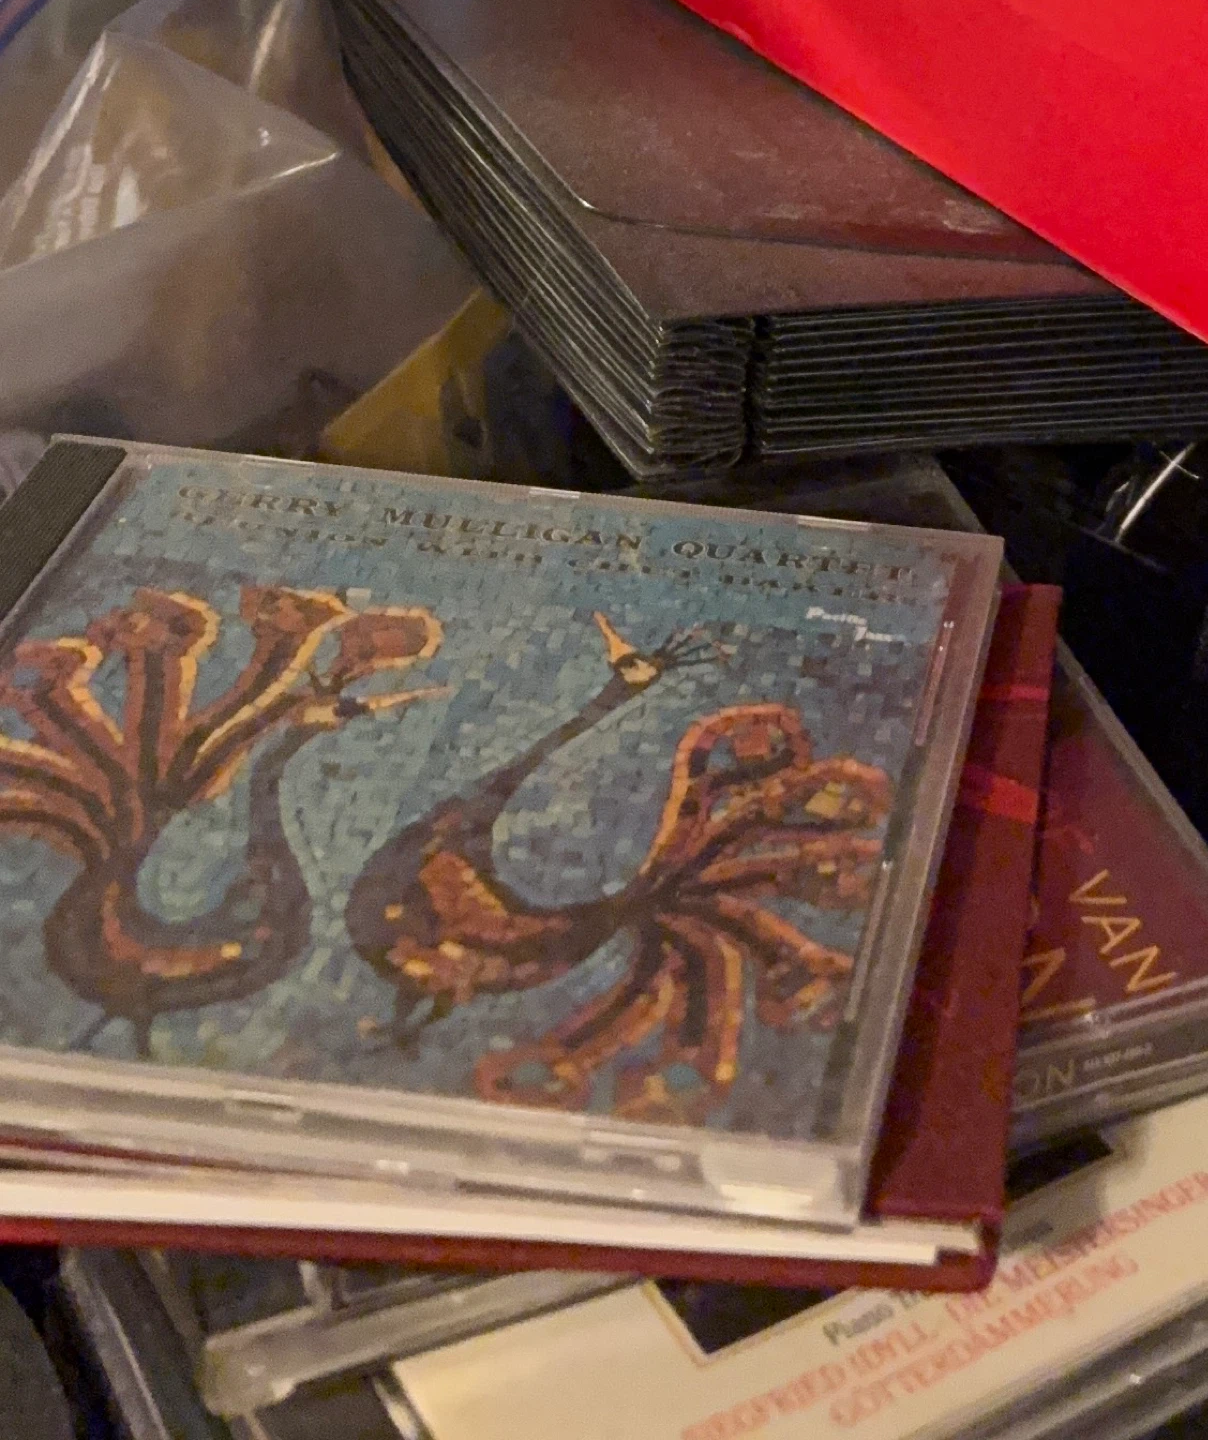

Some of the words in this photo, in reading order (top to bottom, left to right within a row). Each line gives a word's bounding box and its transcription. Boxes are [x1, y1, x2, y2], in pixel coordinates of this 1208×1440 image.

[383, 505, 642, 550] MULLIGAN
[671, 540, 913, 582] QUARTET
[1069, 869, 1178, 995] VAN
